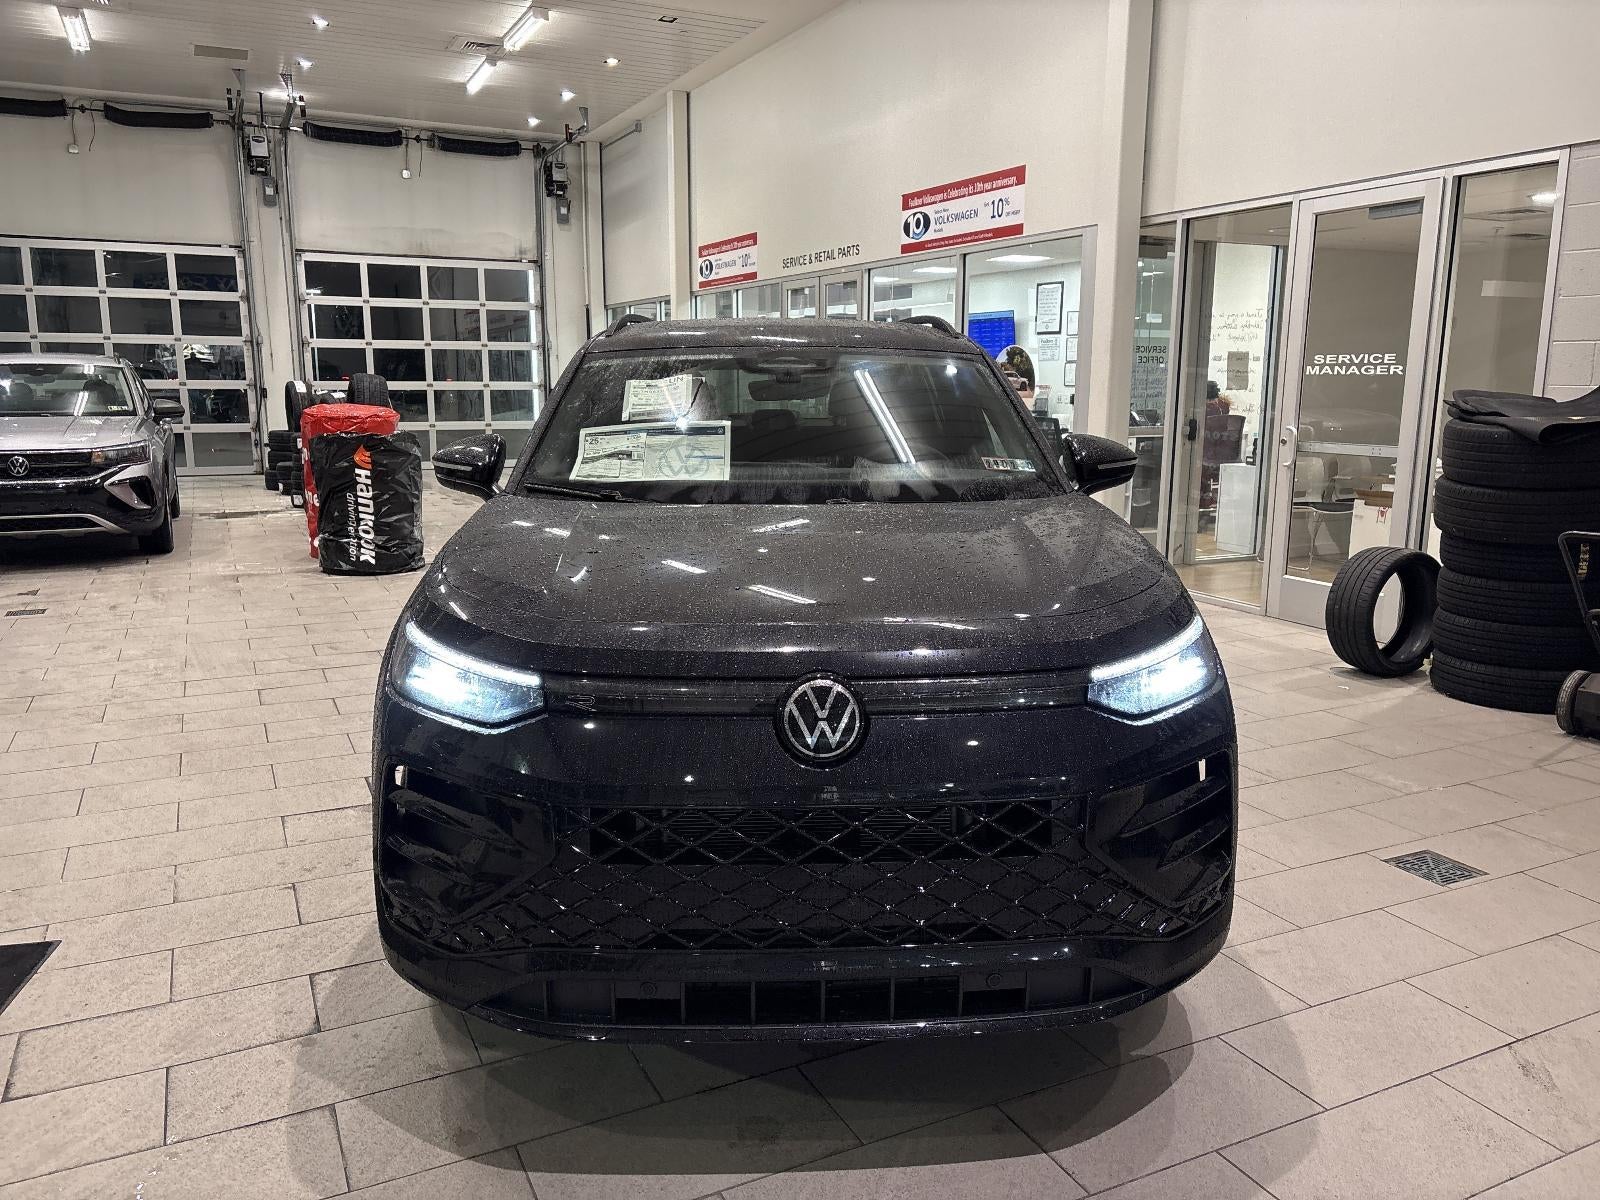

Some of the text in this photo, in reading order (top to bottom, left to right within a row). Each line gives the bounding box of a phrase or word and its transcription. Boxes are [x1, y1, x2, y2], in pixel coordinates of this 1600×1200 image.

[984, 182, 993, 194] year
[933, 208, 979, 226] VOLKSWAGEN
[782, 244, 860, 269] SERVICE & RETAIL PARTS
[1313, 353, 1397, 364] SERVICE
[1305, 365, 1404, 375] MANAGER
[354, 468, 376, 565] Hankook
